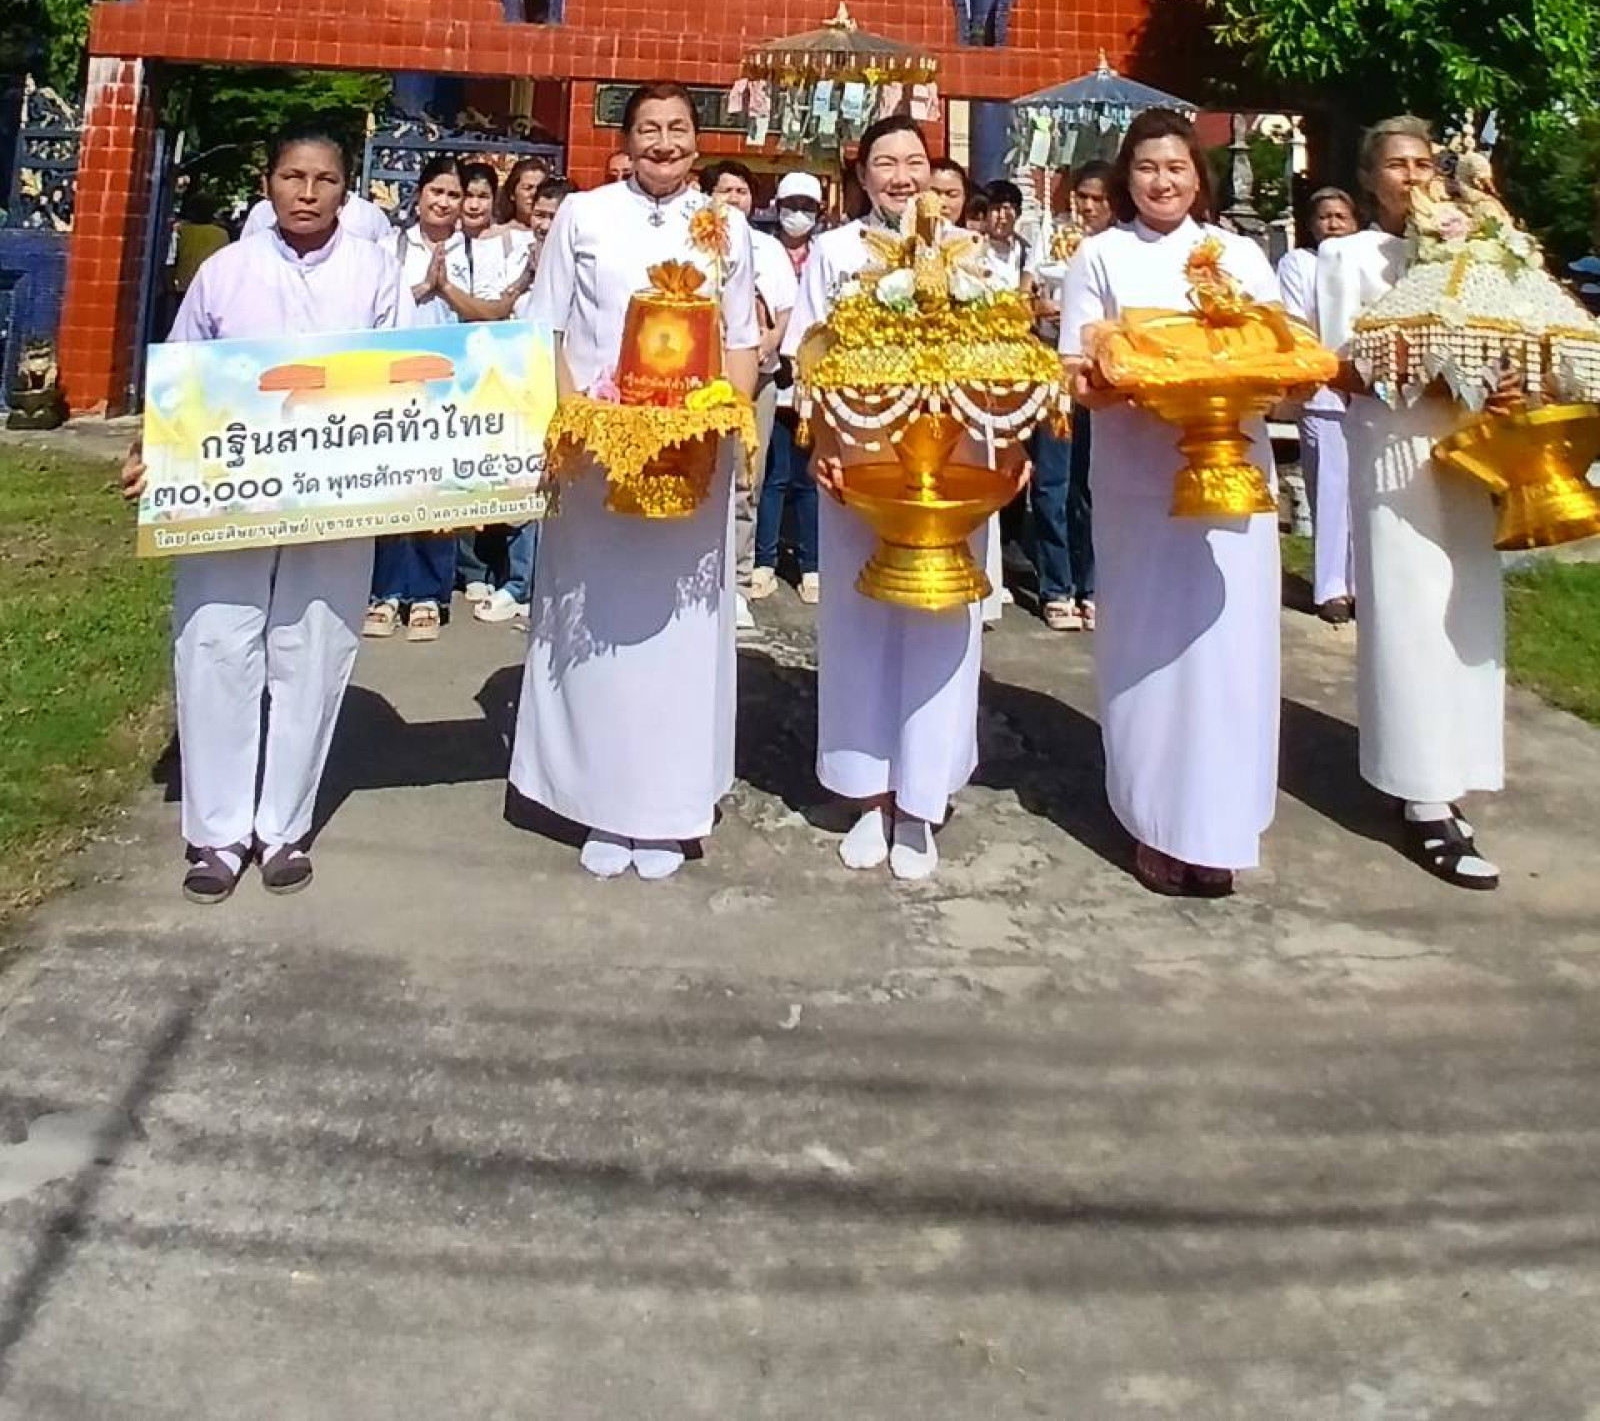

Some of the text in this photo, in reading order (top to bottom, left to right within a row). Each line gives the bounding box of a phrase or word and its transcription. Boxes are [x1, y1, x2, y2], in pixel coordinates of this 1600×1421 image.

[201, 399, 505, 468] กฐินสามัคคีทั่วไทย
[153, 453, 547, 508] ๓๐,๐๐๐ วัด พุทธศักราช ๒๕๖๘
[156, 531, 185, 547] โดย
